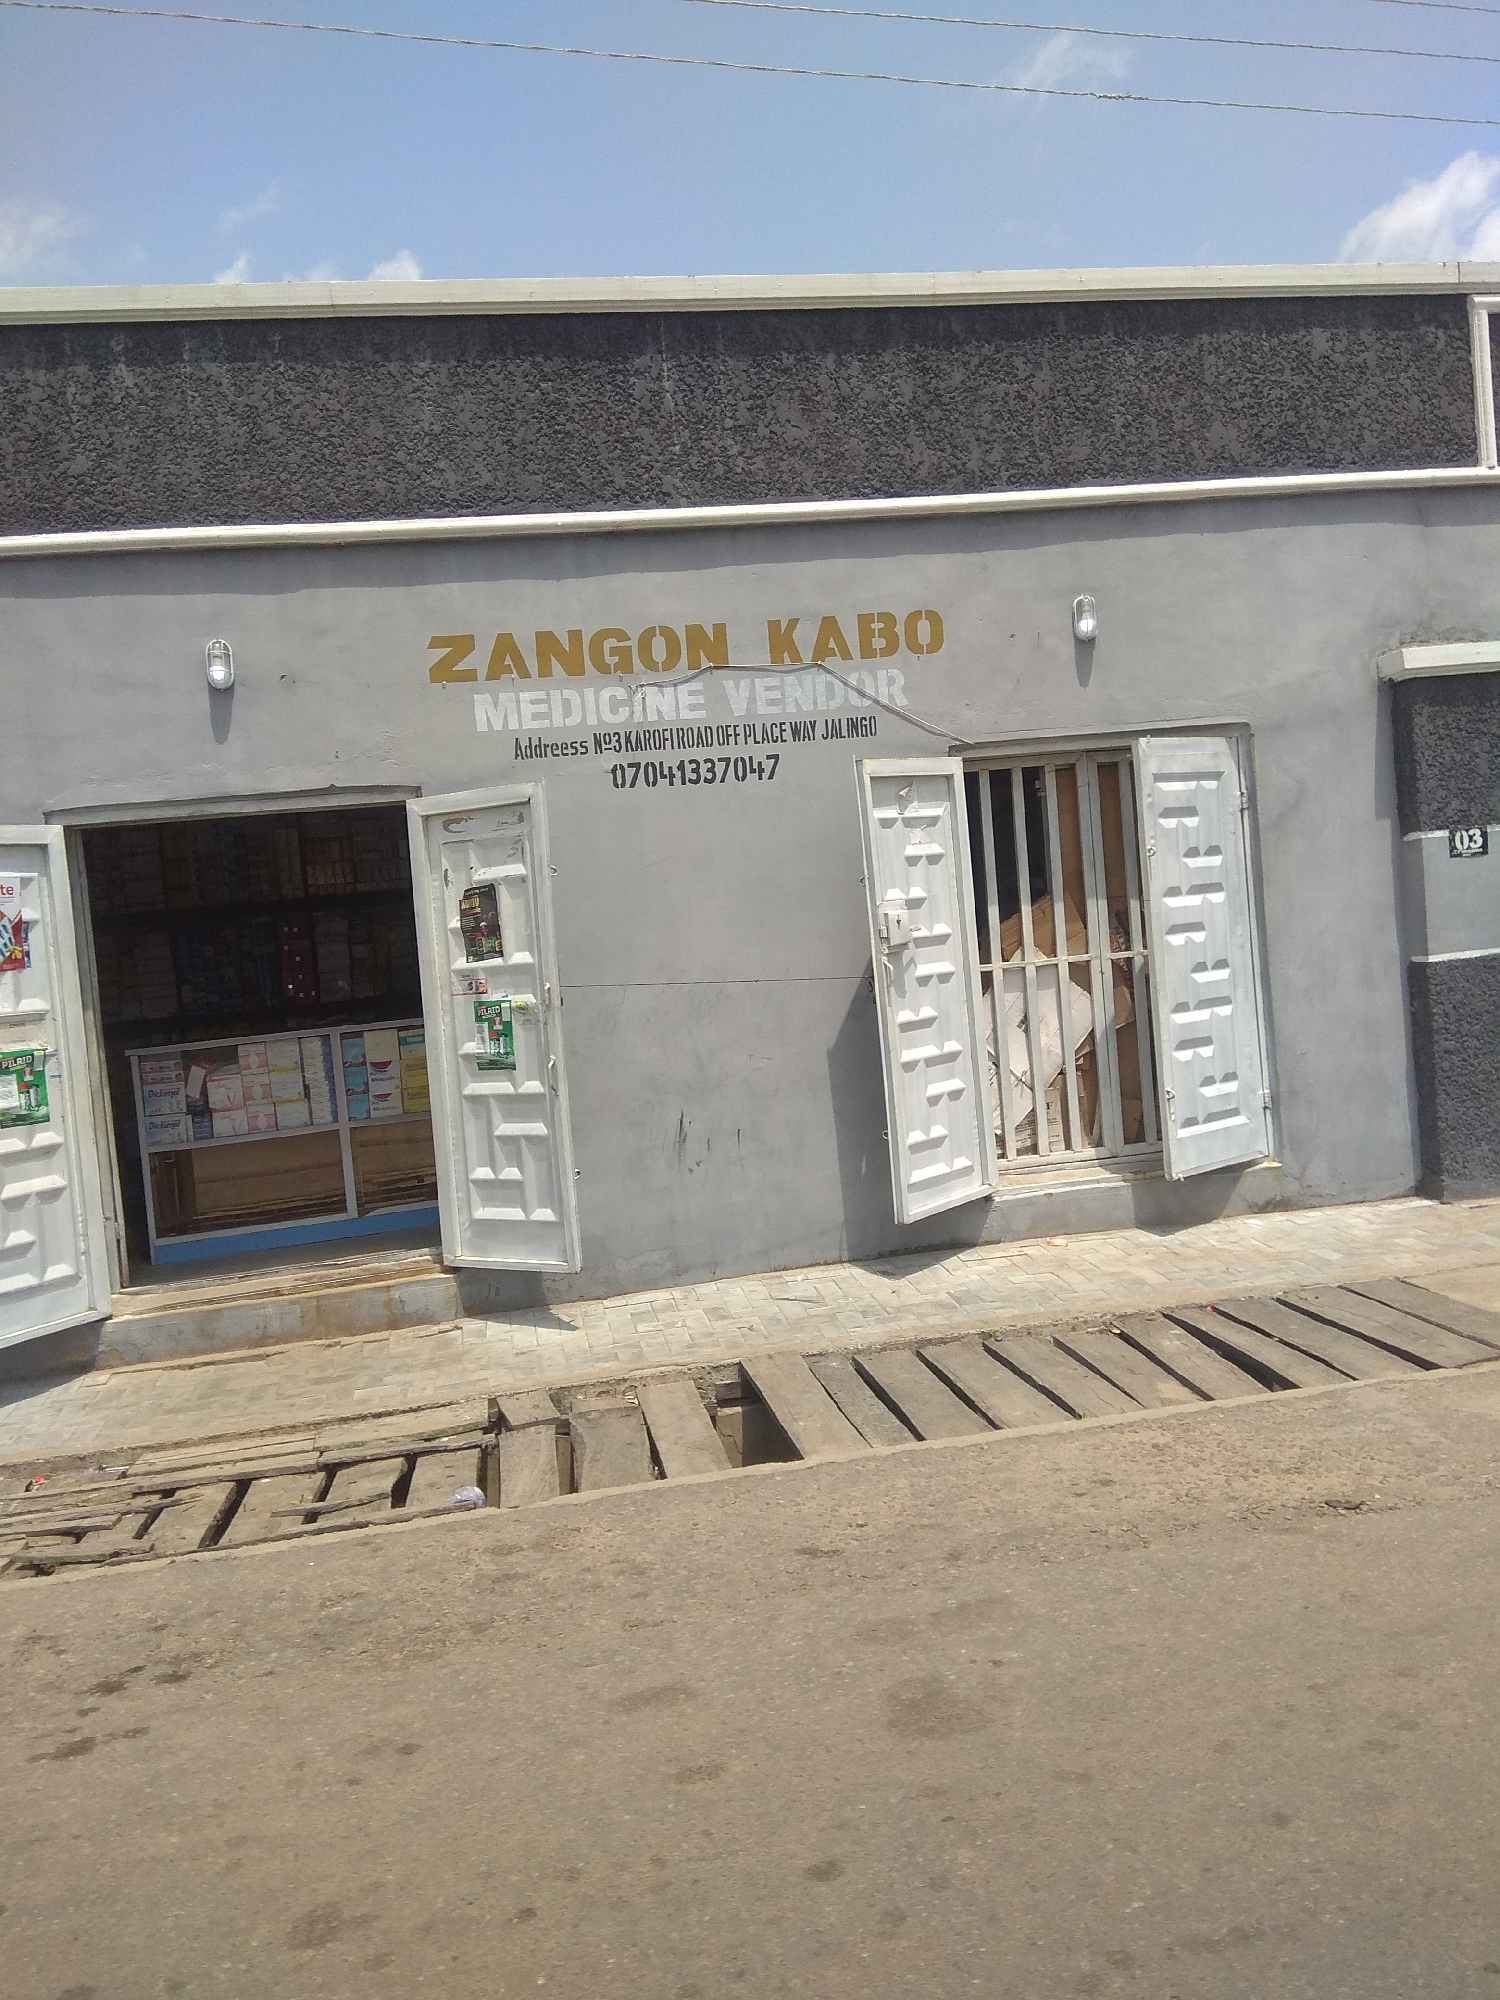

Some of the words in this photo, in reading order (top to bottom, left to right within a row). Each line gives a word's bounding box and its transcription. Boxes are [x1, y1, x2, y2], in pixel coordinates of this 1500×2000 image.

[427, 621, 730, 684] ZANGON
[766, 609, 945, 665] KABO
[473, 681, 707, 732] MEDICINE
[722, 668, 910, 717] VENDOR
[514, 735, 589, 761] Addreess
[624, 727, 675, 752] KAROFI
[676, 725, 714, 750] ROAD
[716, 724, 741, 747] OFF
[743, 722, 788, 745] PLACE
[789, 719, 817, 743] WAY
[821, 715, 878, 740] JALINGO
[610, 753, 780, 789] 07041337047
[1454, 828, 1483, 850] 03
[1, 1055, 33, 1070] PILRID
